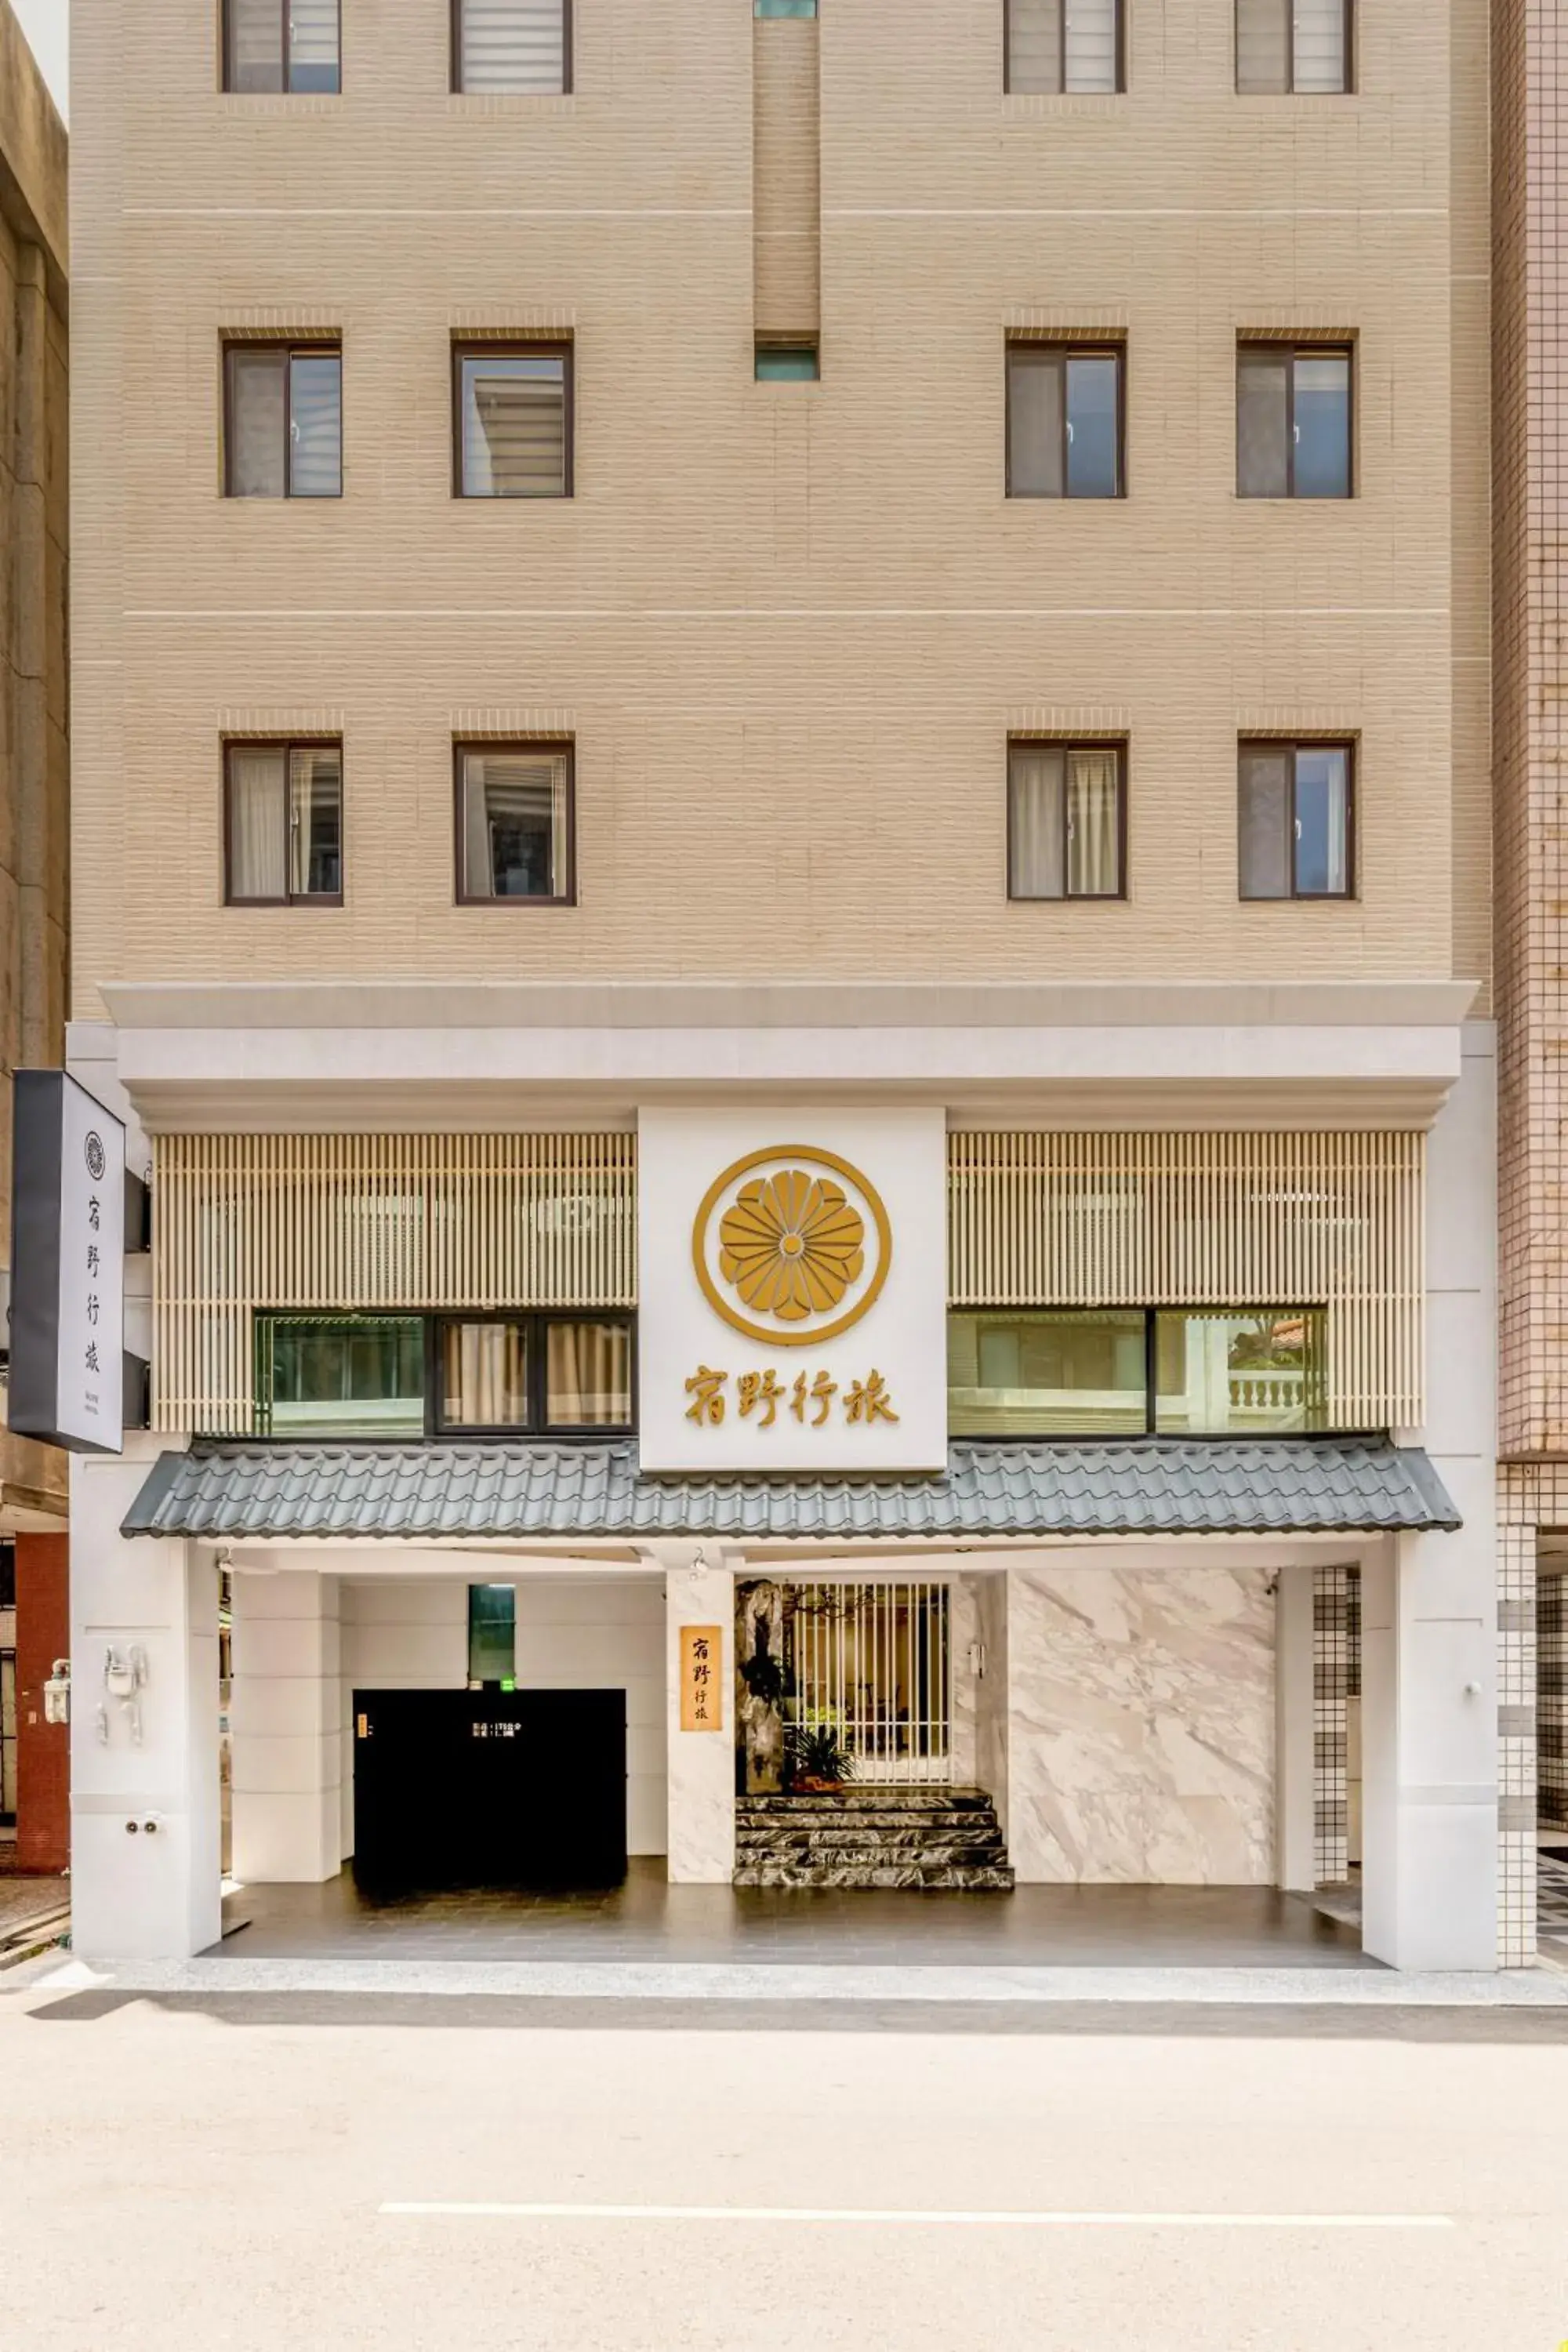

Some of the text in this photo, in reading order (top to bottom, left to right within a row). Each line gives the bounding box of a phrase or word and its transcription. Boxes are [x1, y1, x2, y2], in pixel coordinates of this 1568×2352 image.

[85, 1195, 100, 1373] 宿野行旅
[684, 1365, 900, 1427] 宿野行旅
[693, 1639, 711, 1719] 宿野行旅
